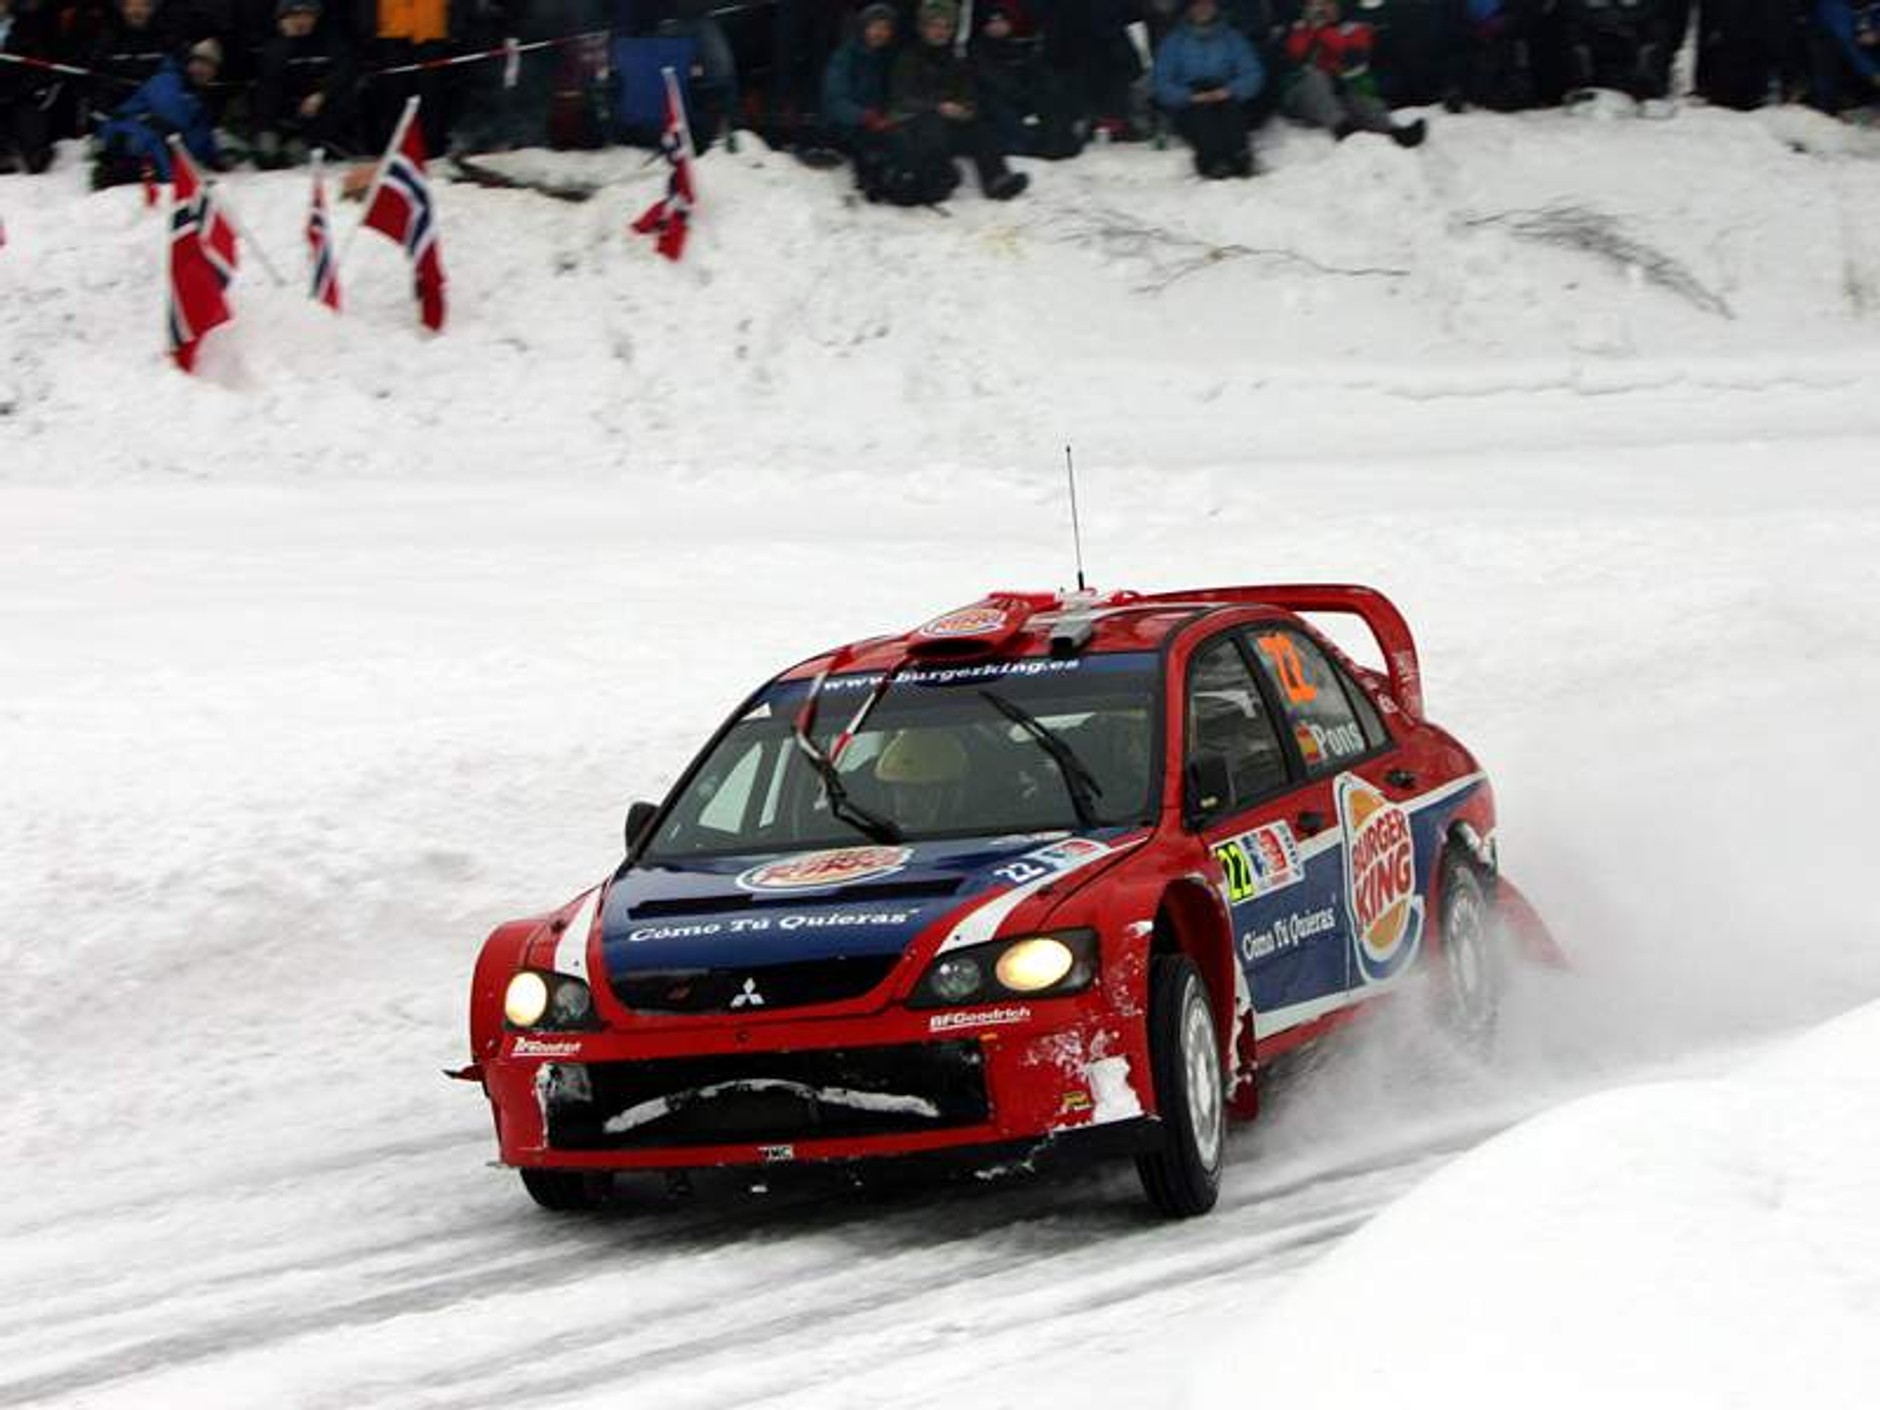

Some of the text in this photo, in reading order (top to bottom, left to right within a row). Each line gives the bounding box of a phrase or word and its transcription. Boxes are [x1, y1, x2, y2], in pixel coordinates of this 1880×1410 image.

[1256, 631, 1318, 705] 22
[1311, 721, 1365, 760] Pons
[993, 862, 1046, 882] 22
[1217, 842, 1253, 901] 22
[1352, 808, 1409, 884] BURGER
[1355, 841, 1411, 937] KING
